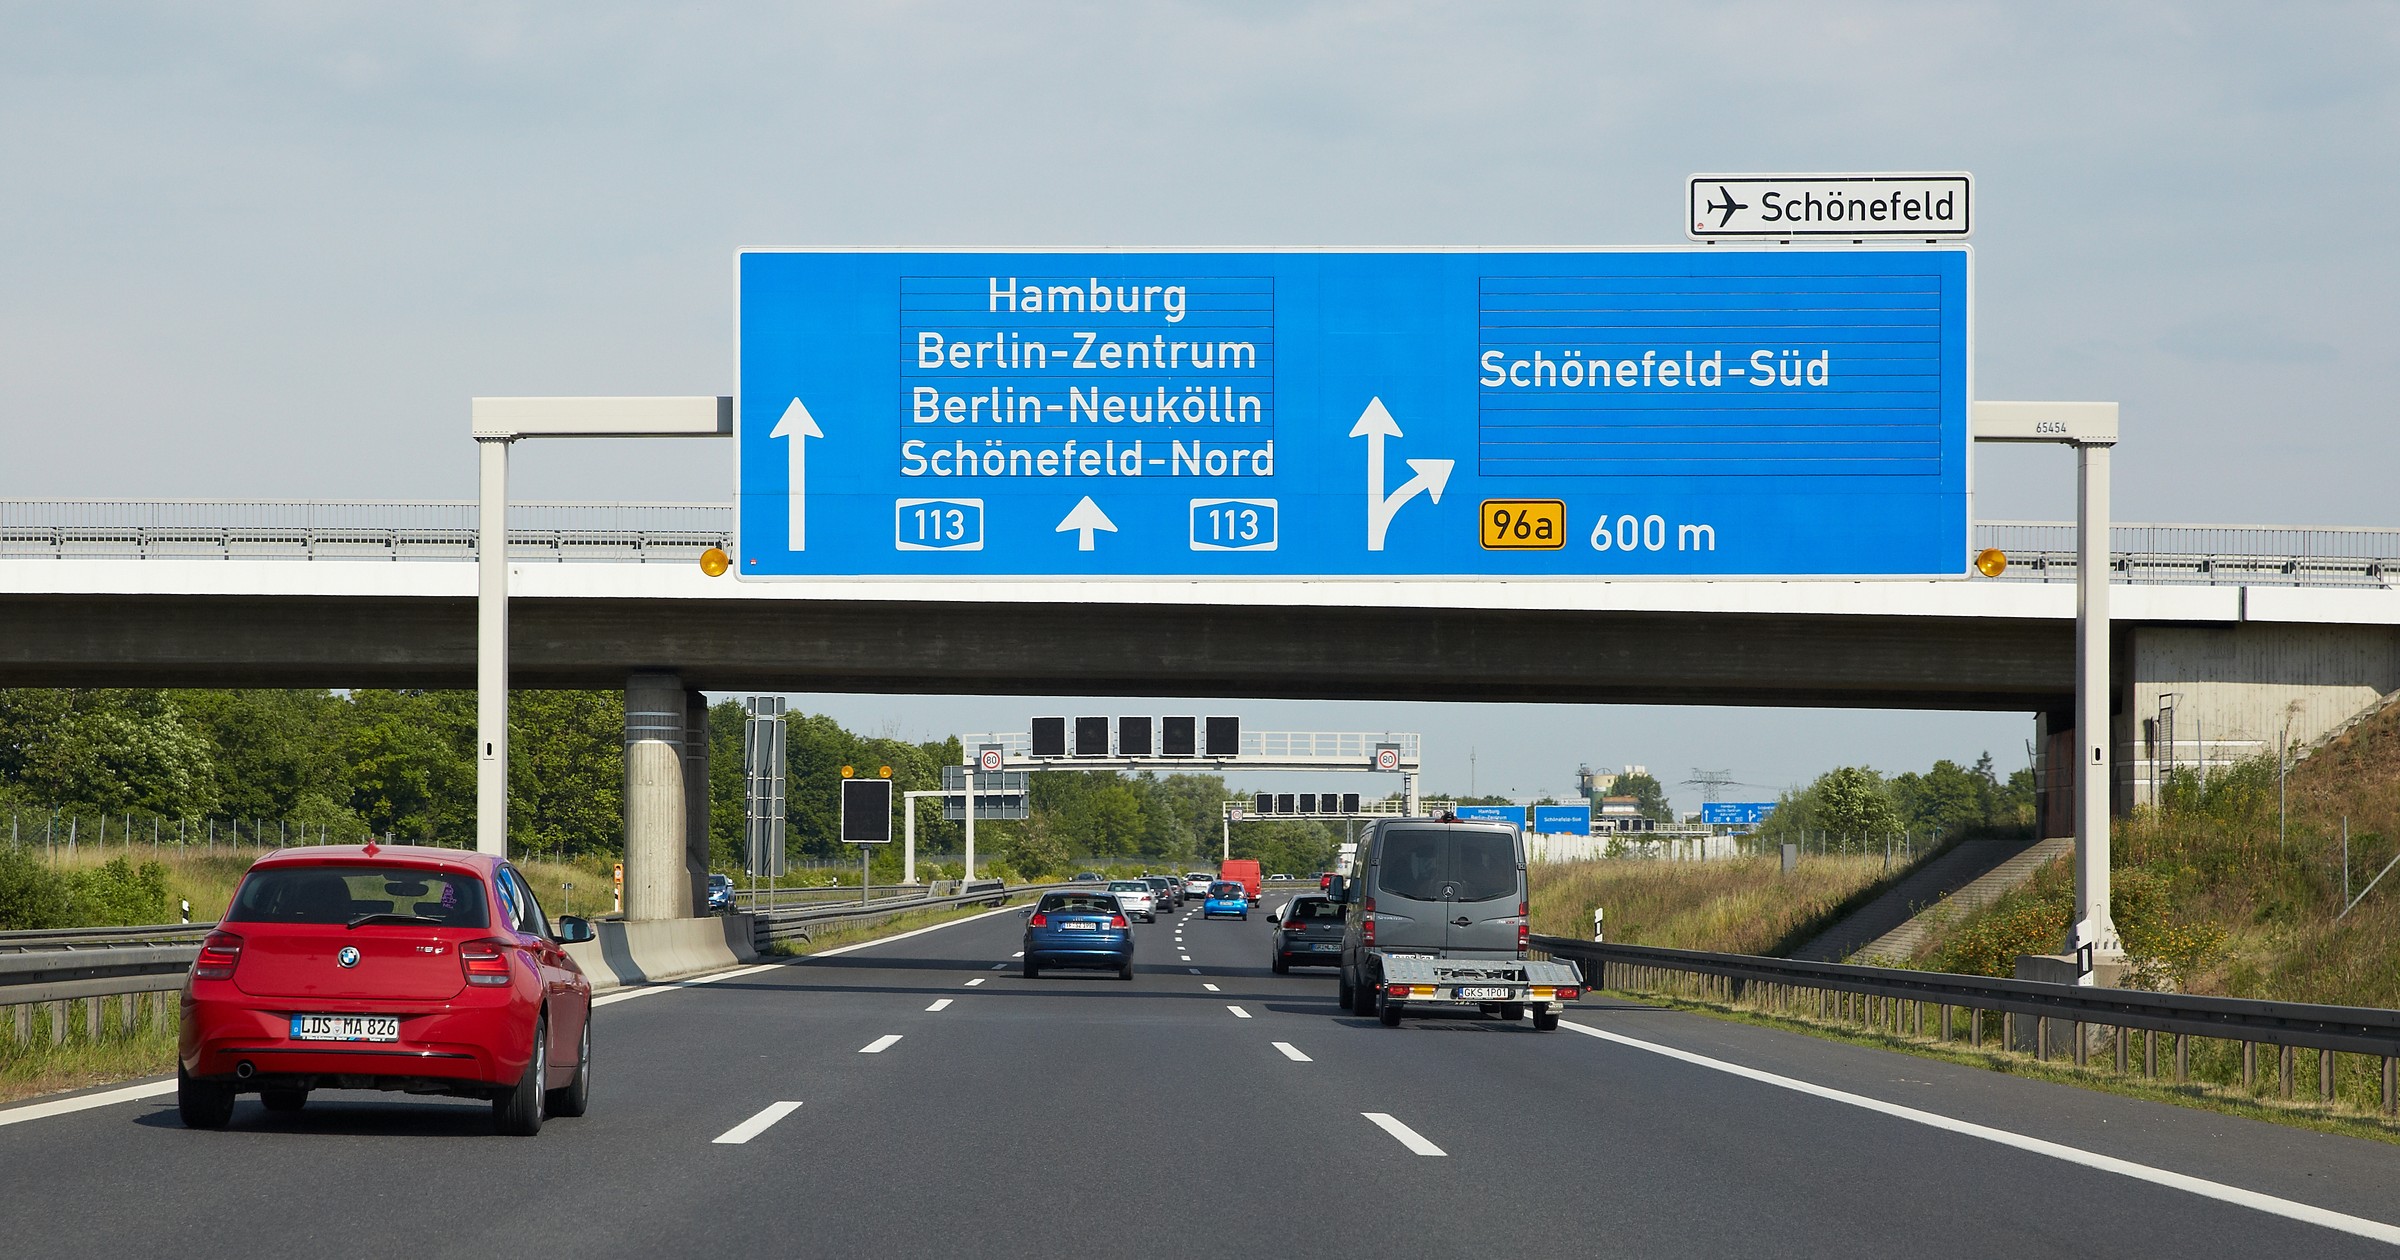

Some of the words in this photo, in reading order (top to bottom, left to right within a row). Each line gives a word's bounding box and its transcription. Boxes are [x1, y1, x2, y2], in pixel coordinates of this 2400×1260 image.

[1762, 191, 1952, 221] Schönefeld
[990, 278, 1185, 322] Hamburg
[919, 332, 1255, 368] Berlin-Zentrum
[1481, 349, 1829, 387] Schönefeld-Süd
[914, 387, 1260, 423] Berlin-Neukölln
[2036, 422, 2067, 434] 65454
[902, 440, 1273, 476] Schönefeld-Nord
[915, 510, 964, 540] 113
[1210, 510, 1258, 540] 113
[1494, 510, 1552, 540] 96a
[1590, 515, 1665, 552] 600
[1678, 525, 1715, 552] m
[986, 755, 997, 765] 80
[1382, 755, 1394, 764] 80
[1464, 988, 1483, 997] GKS
[301, 1016, 331, 1034] LDS
[343, 1018, 362, 1035] MA
[367, 1018, 396, 1036] 826
